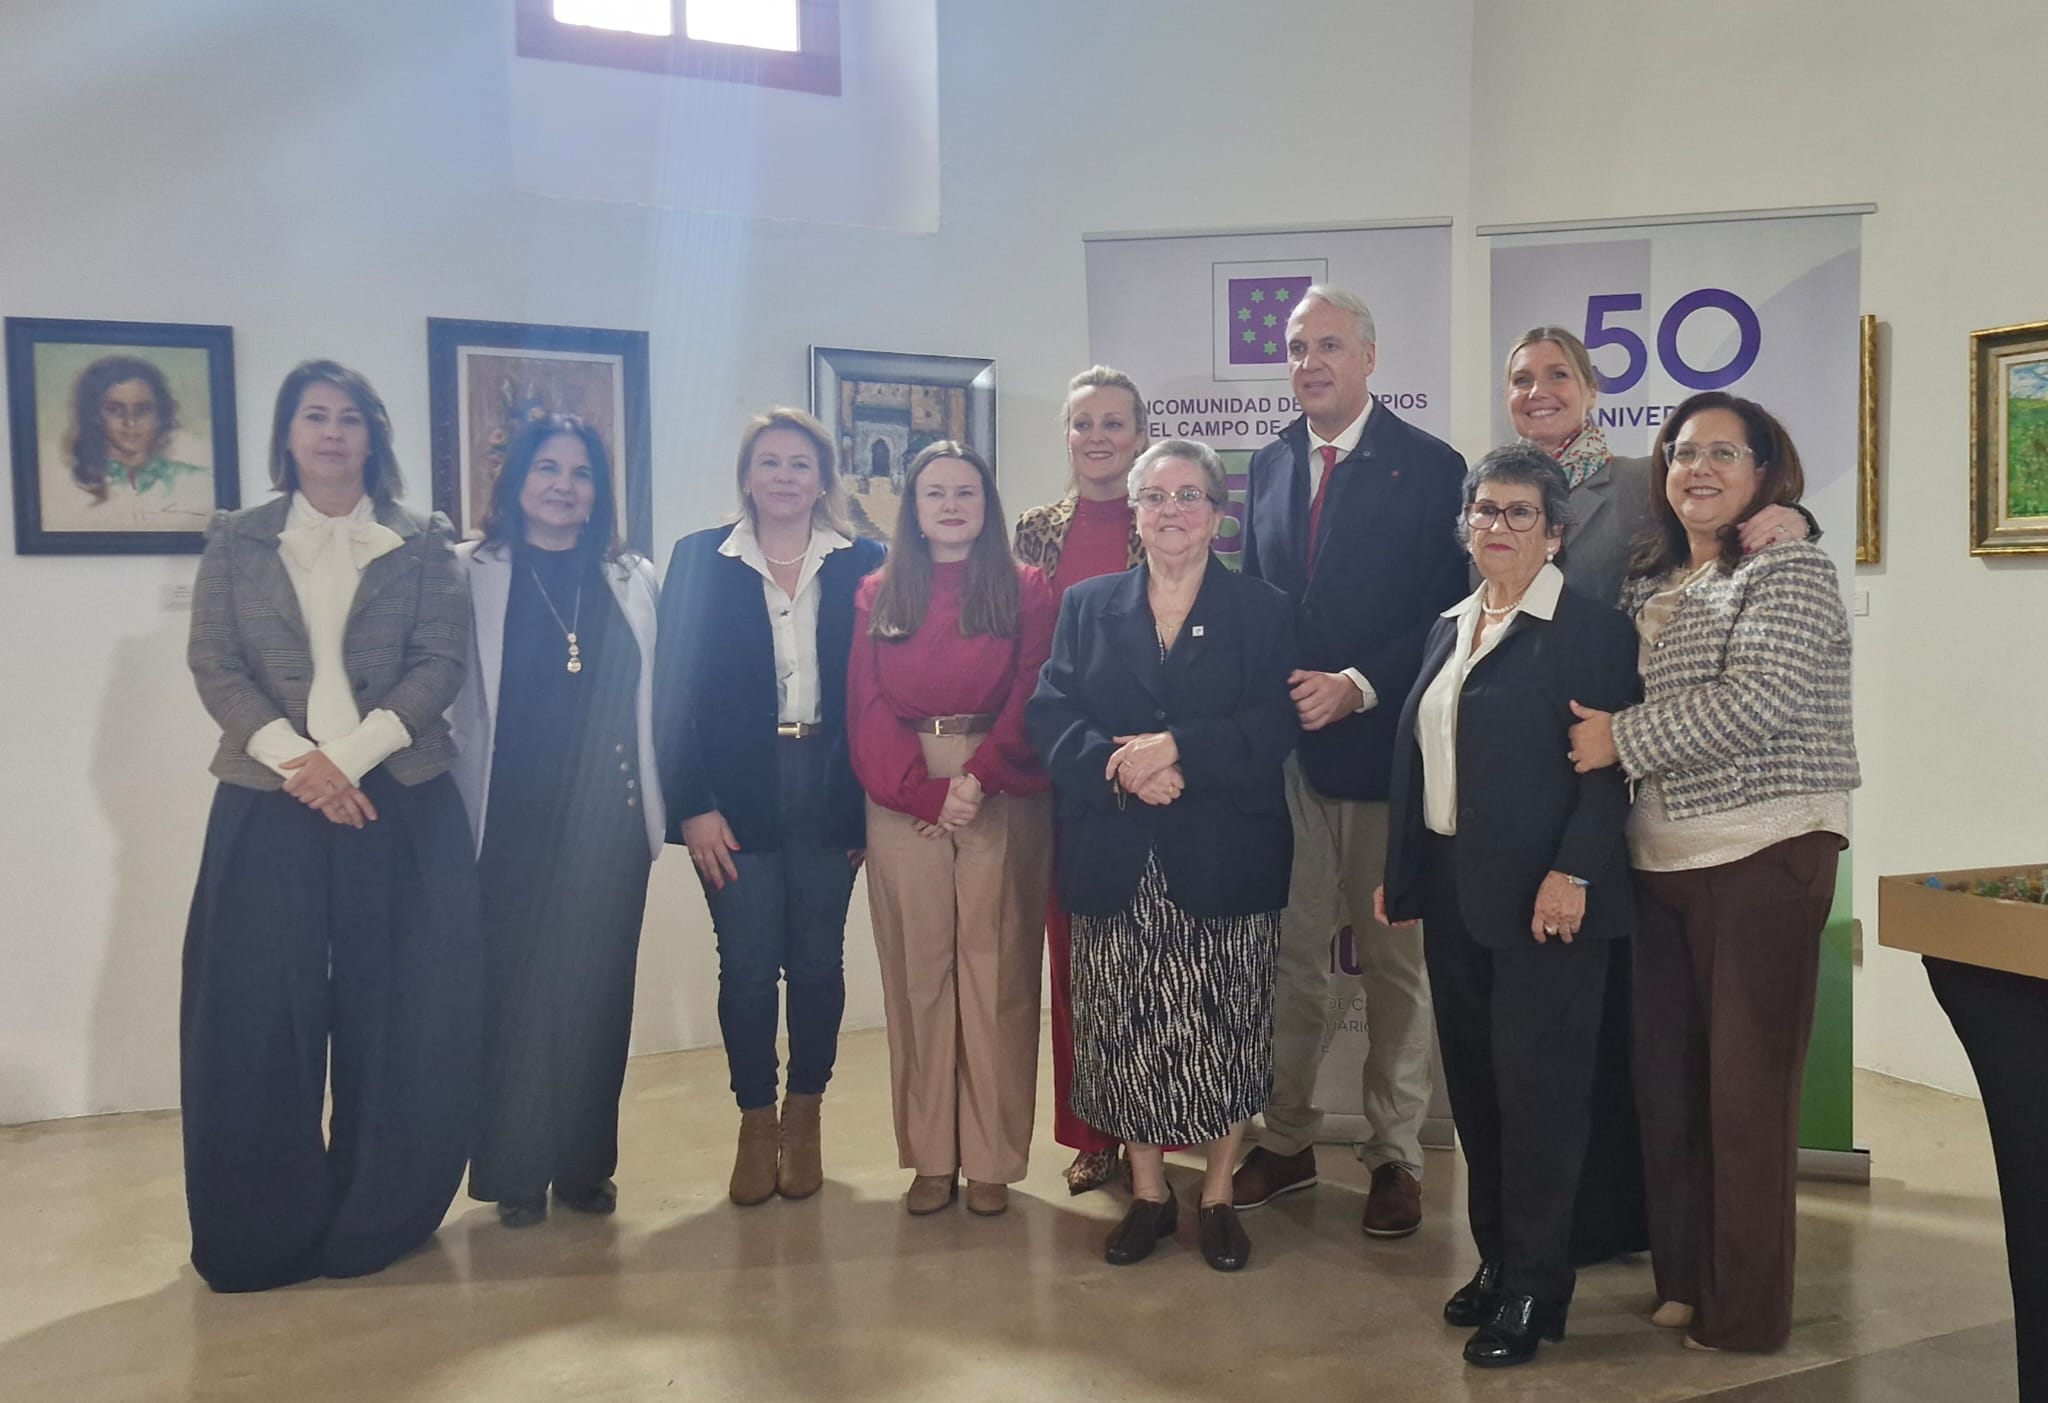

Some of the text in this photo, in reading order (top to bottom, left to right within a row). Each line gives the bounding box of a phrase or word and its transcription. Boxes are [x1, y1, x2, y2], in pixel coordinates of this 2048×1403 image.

[1584, 288, 1762, 395] 50
[1178, 420, 1249, 437] CAMPO
[1256, 420, 1281, 435] DE
